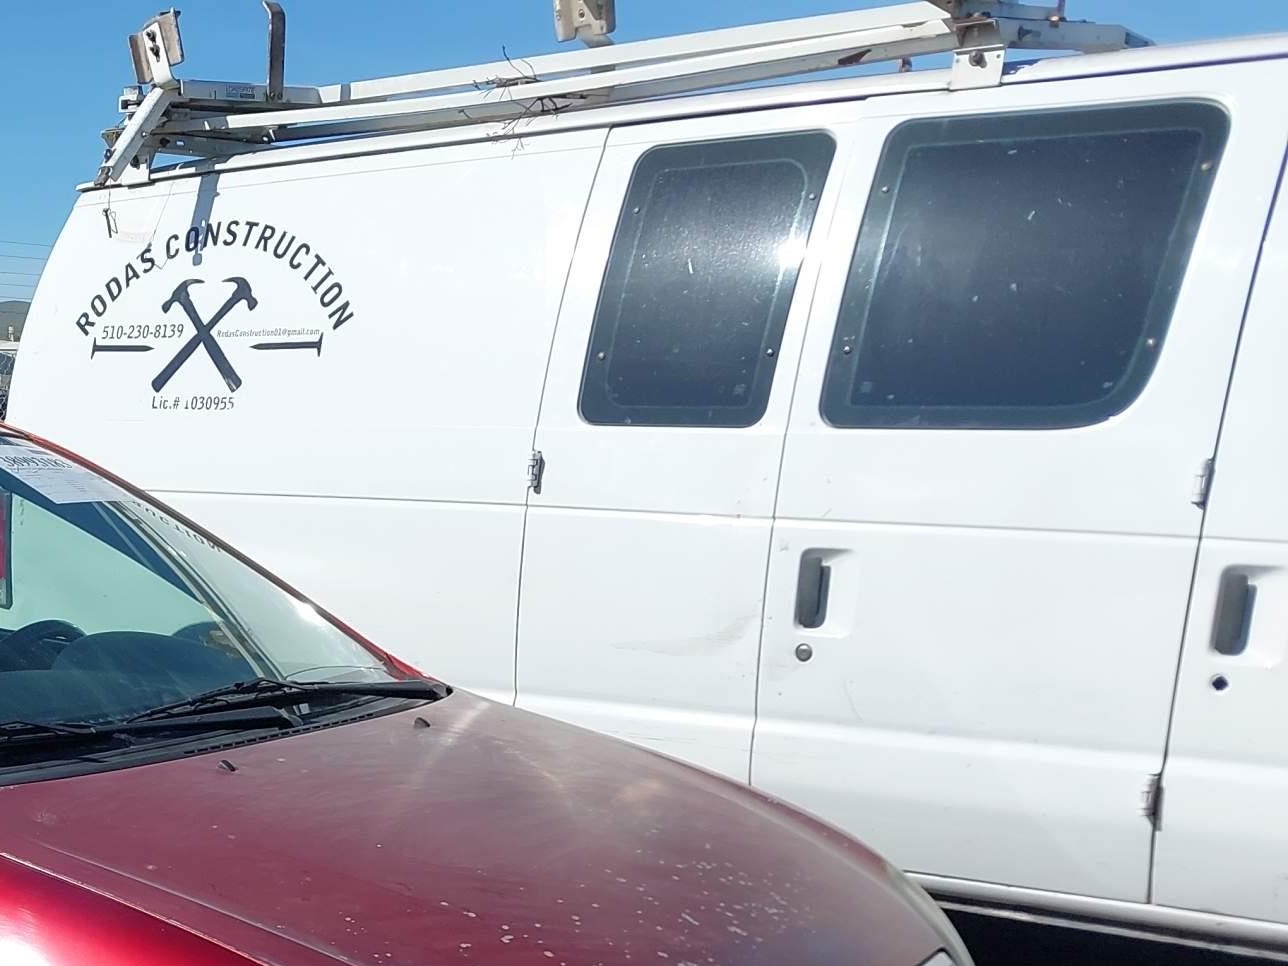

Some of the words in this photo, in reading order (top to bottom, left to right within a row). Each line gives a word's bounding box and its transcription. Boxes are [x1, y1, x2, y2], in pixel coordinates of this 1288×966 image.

[75, 246, 156, 337] RODAS
[165, 220, 354, 331] CONSTRUCTION
[101, 323, 185, 341] 510-230-8139
